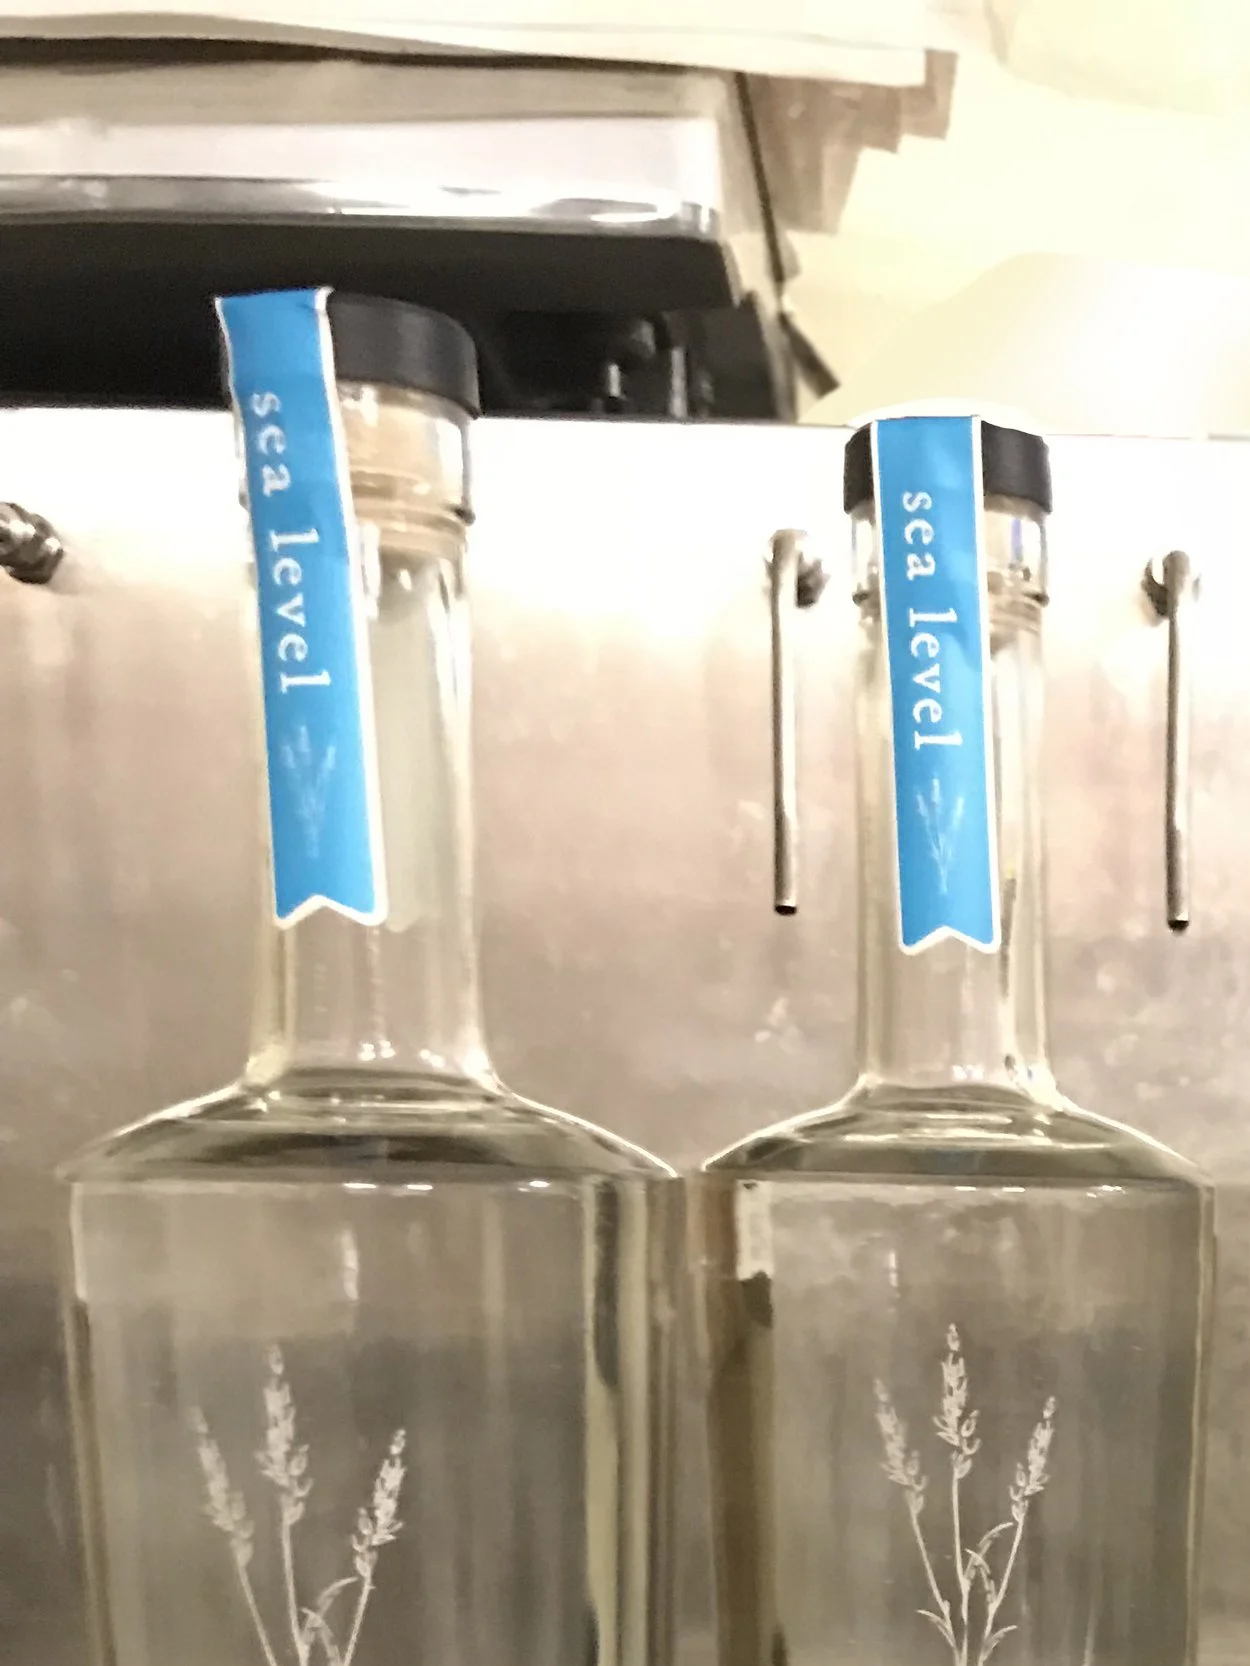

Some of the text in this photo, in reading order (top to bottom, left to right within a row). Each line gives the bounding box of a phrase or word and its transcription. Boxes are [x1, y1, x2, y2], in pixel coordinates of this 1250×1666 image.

[250, 390, 332, 696] sea level
[901, 489, 964, 752] sea level
